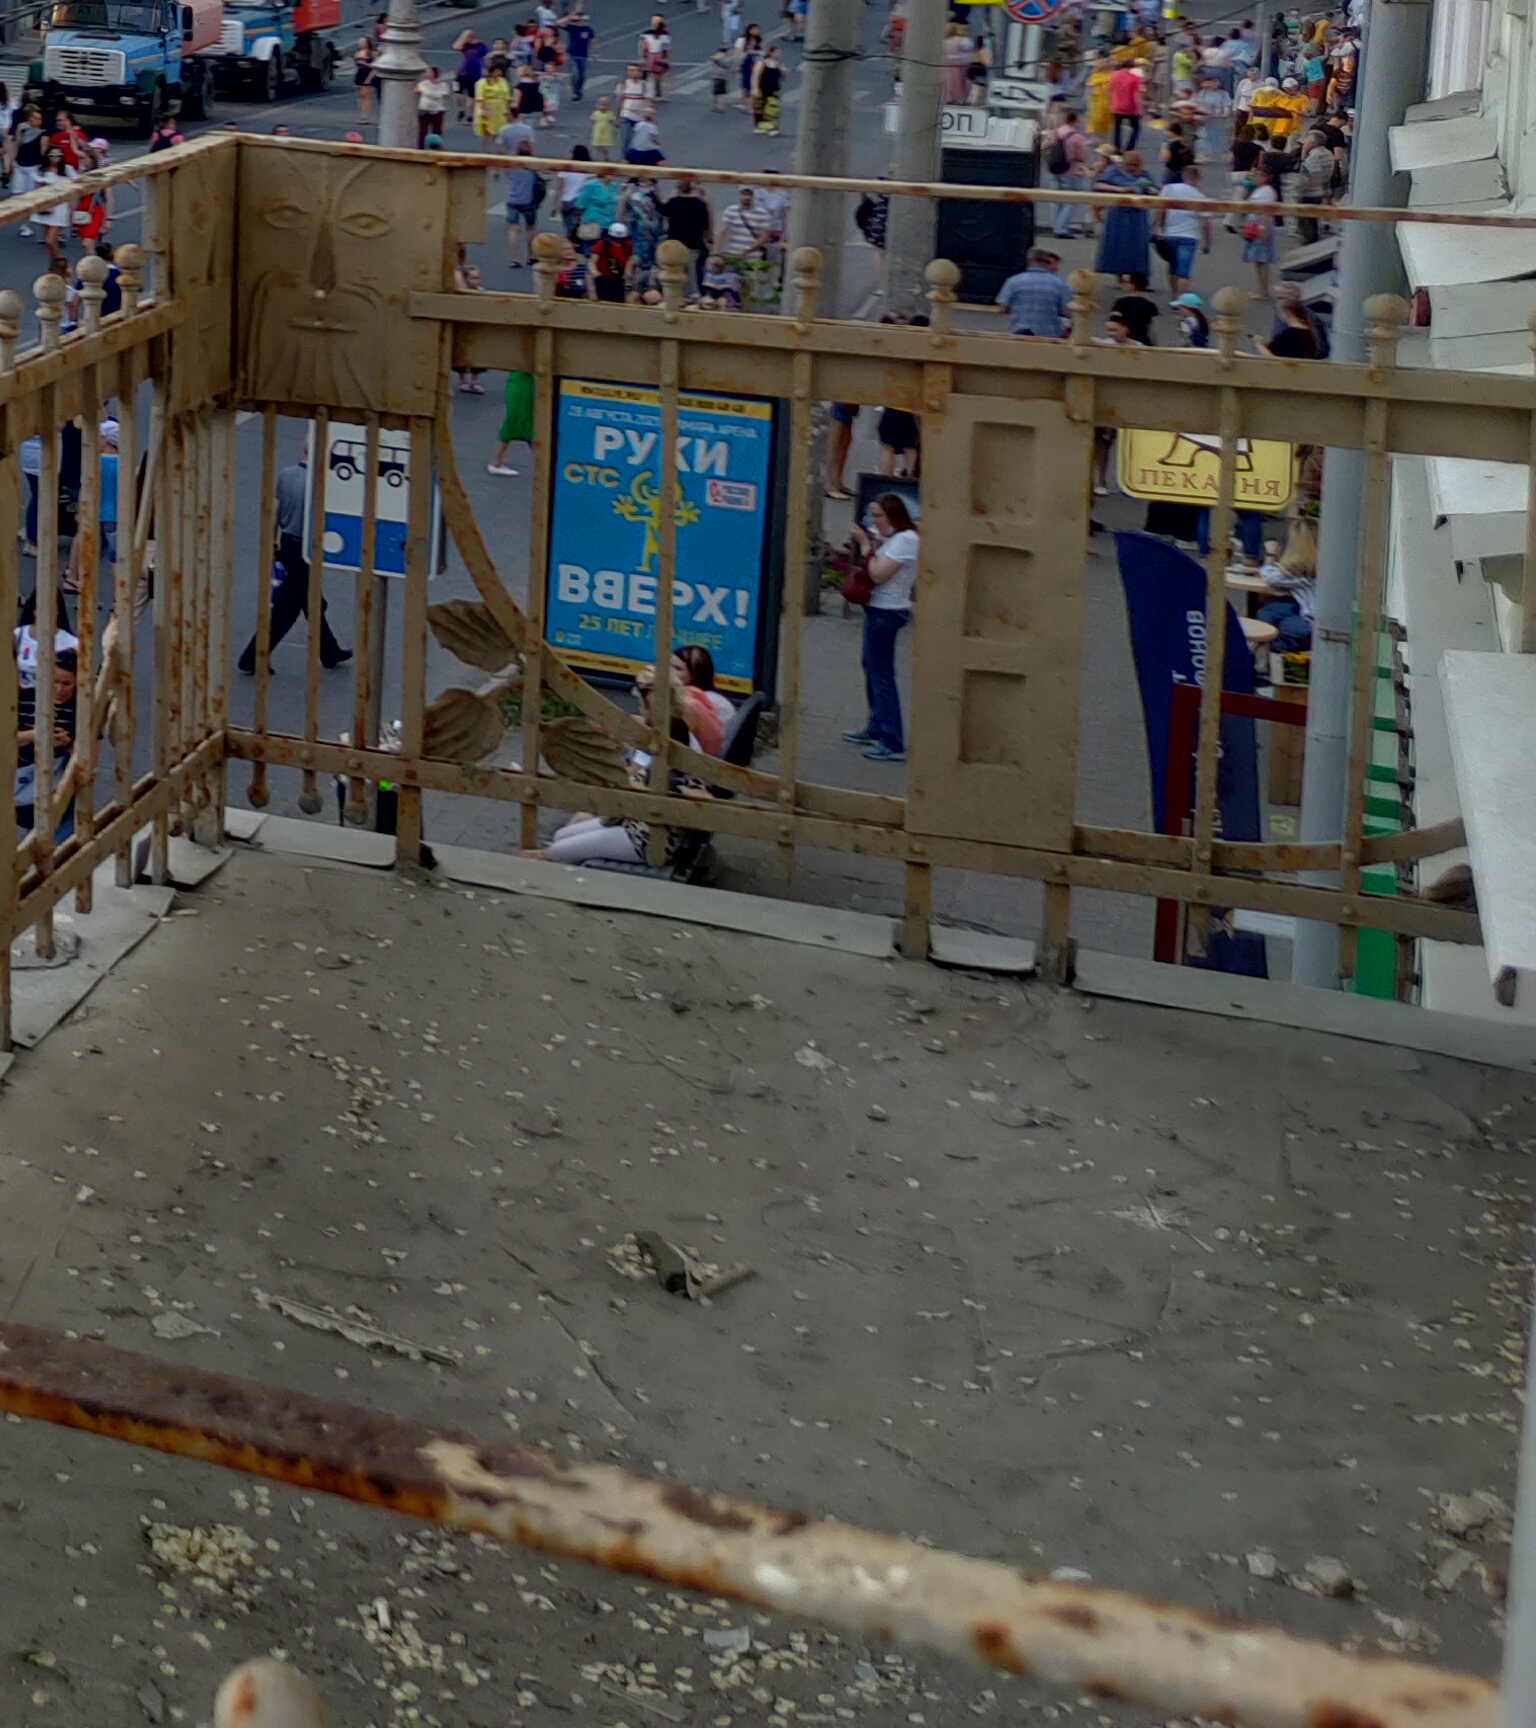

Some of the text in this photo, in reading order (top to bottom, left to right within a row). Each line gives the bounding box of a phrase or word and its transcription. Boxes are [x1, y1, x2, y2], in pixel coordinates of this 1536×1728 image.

[941, 111, 973, 133] ОП
[593, 425, 729, 476] РУКИ
[564, 462, 621, 488] СТС
[1139, 468, 1281, 498] ПЕКАНЯ
[578, 613, 601, 630] 25
[605, 617, 643, 638] ЛЕТ
